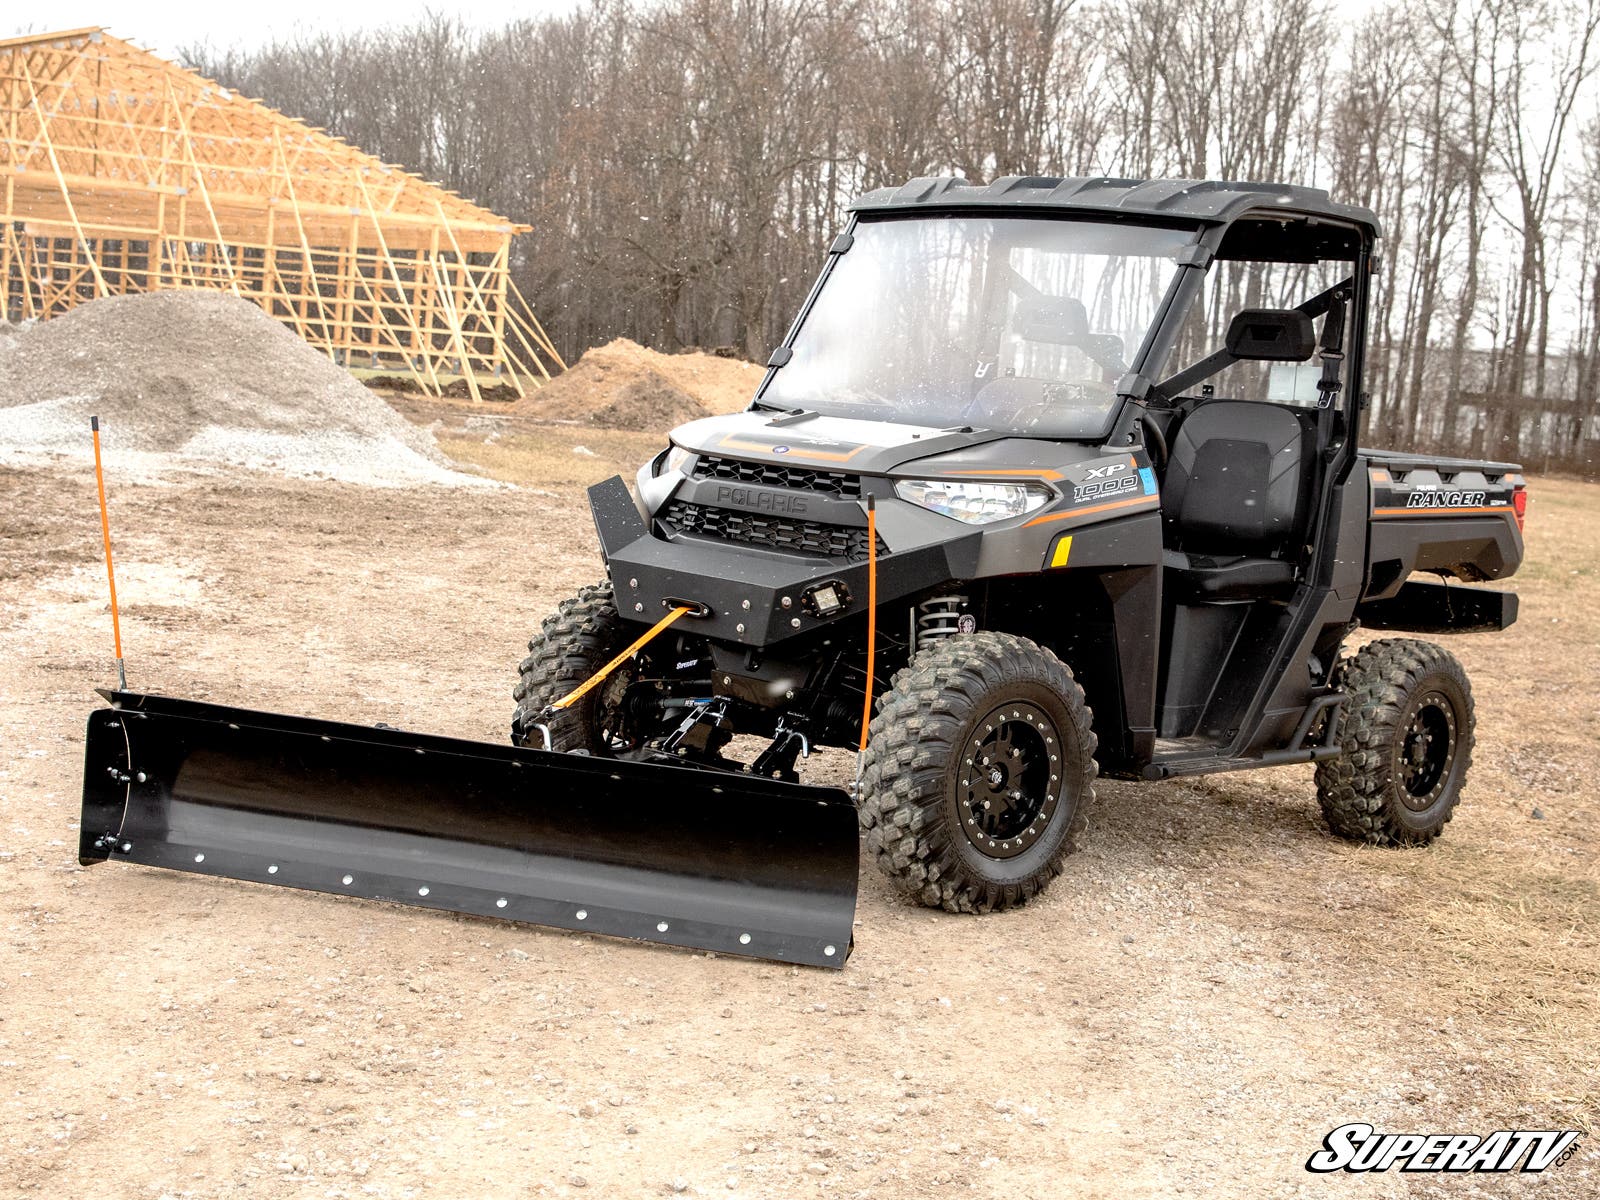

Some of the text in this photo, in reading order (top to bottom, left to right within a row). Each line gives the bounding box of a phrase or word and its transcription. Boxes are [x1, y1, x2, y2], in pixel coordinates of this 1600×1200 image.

[1082, 464, 1127, 482] XP
[1073, 475, 1138, 499] 1000
[718, 487, 808, 513] POLARIS
[1406, 491, 1486, 508] RANGER
